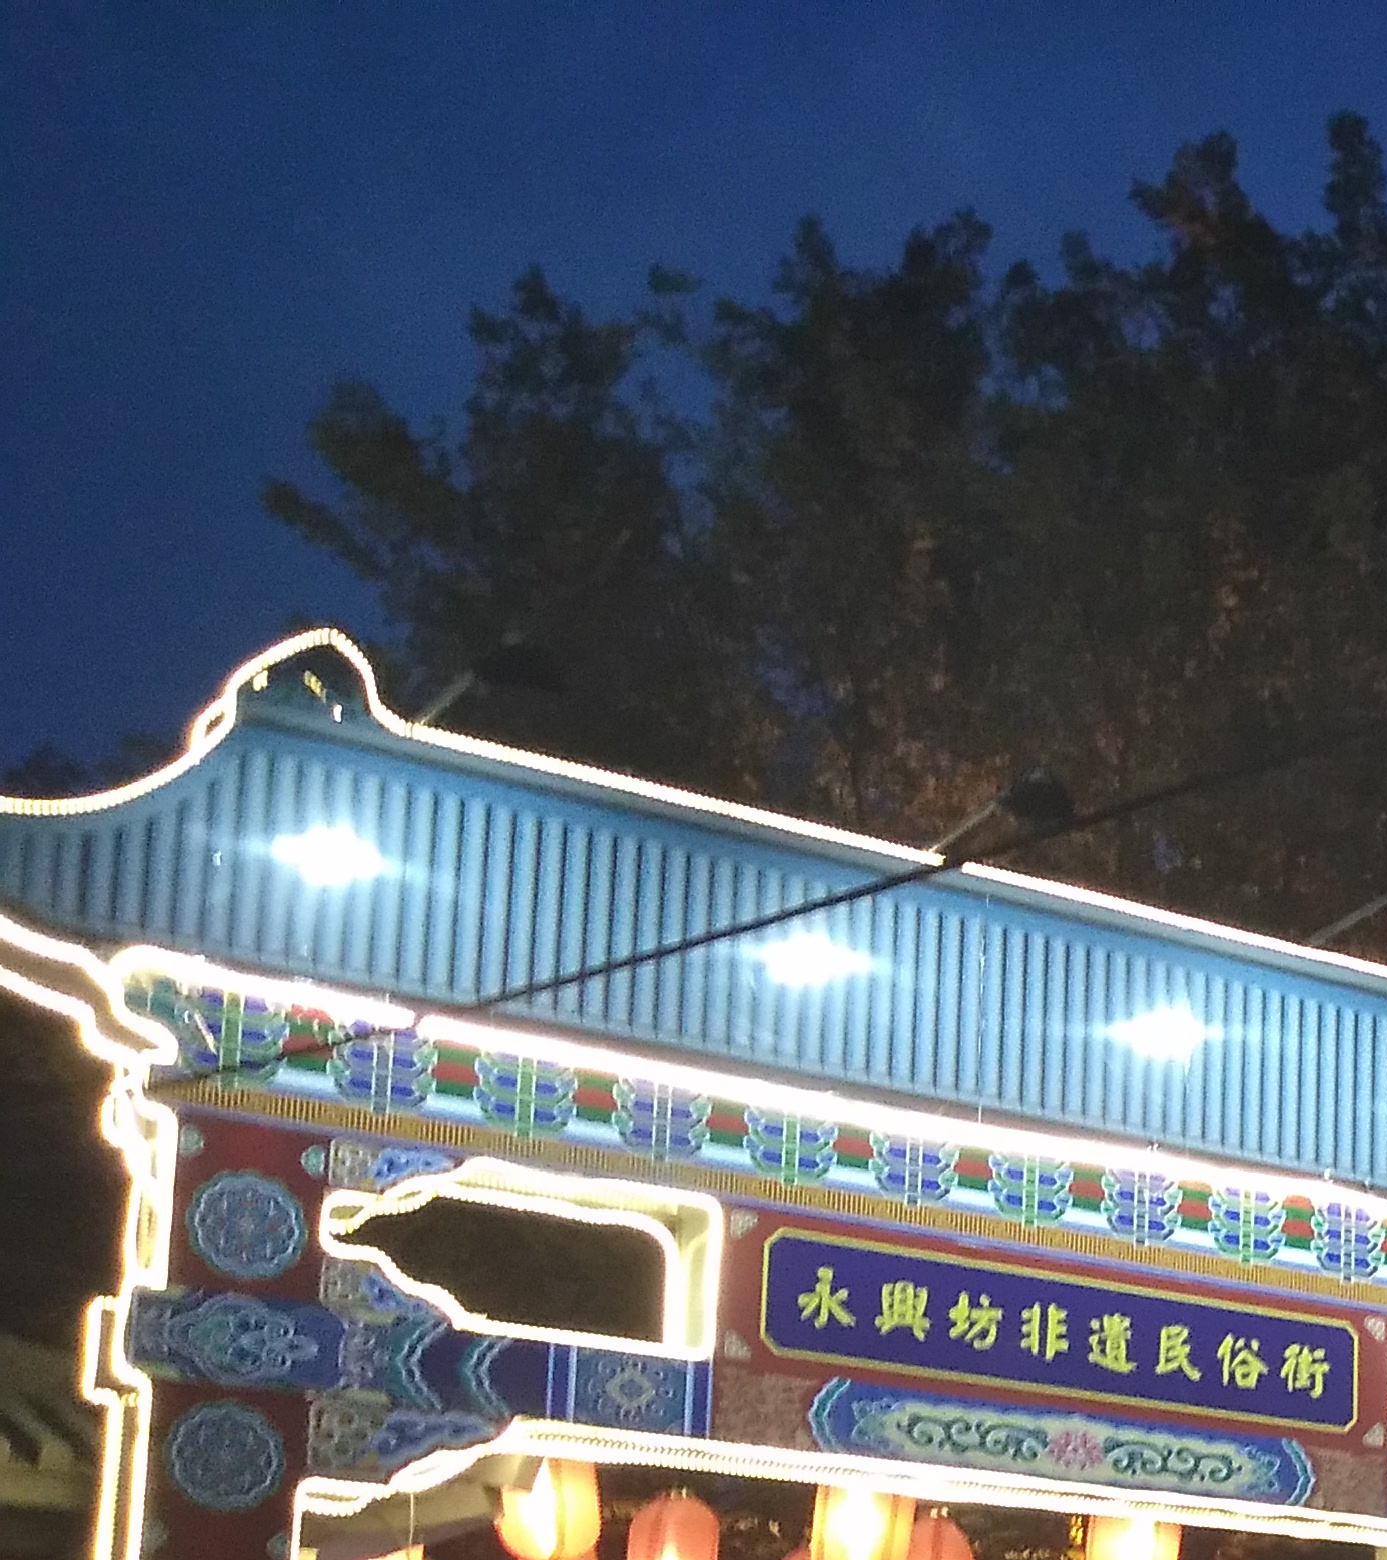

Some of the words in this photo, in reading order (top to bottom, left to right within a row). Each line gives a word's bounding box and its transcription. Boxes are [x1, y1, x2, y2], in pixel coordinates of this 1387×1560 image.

[796, 1265, 1331, 1399] 永興坊非遺民俗街
